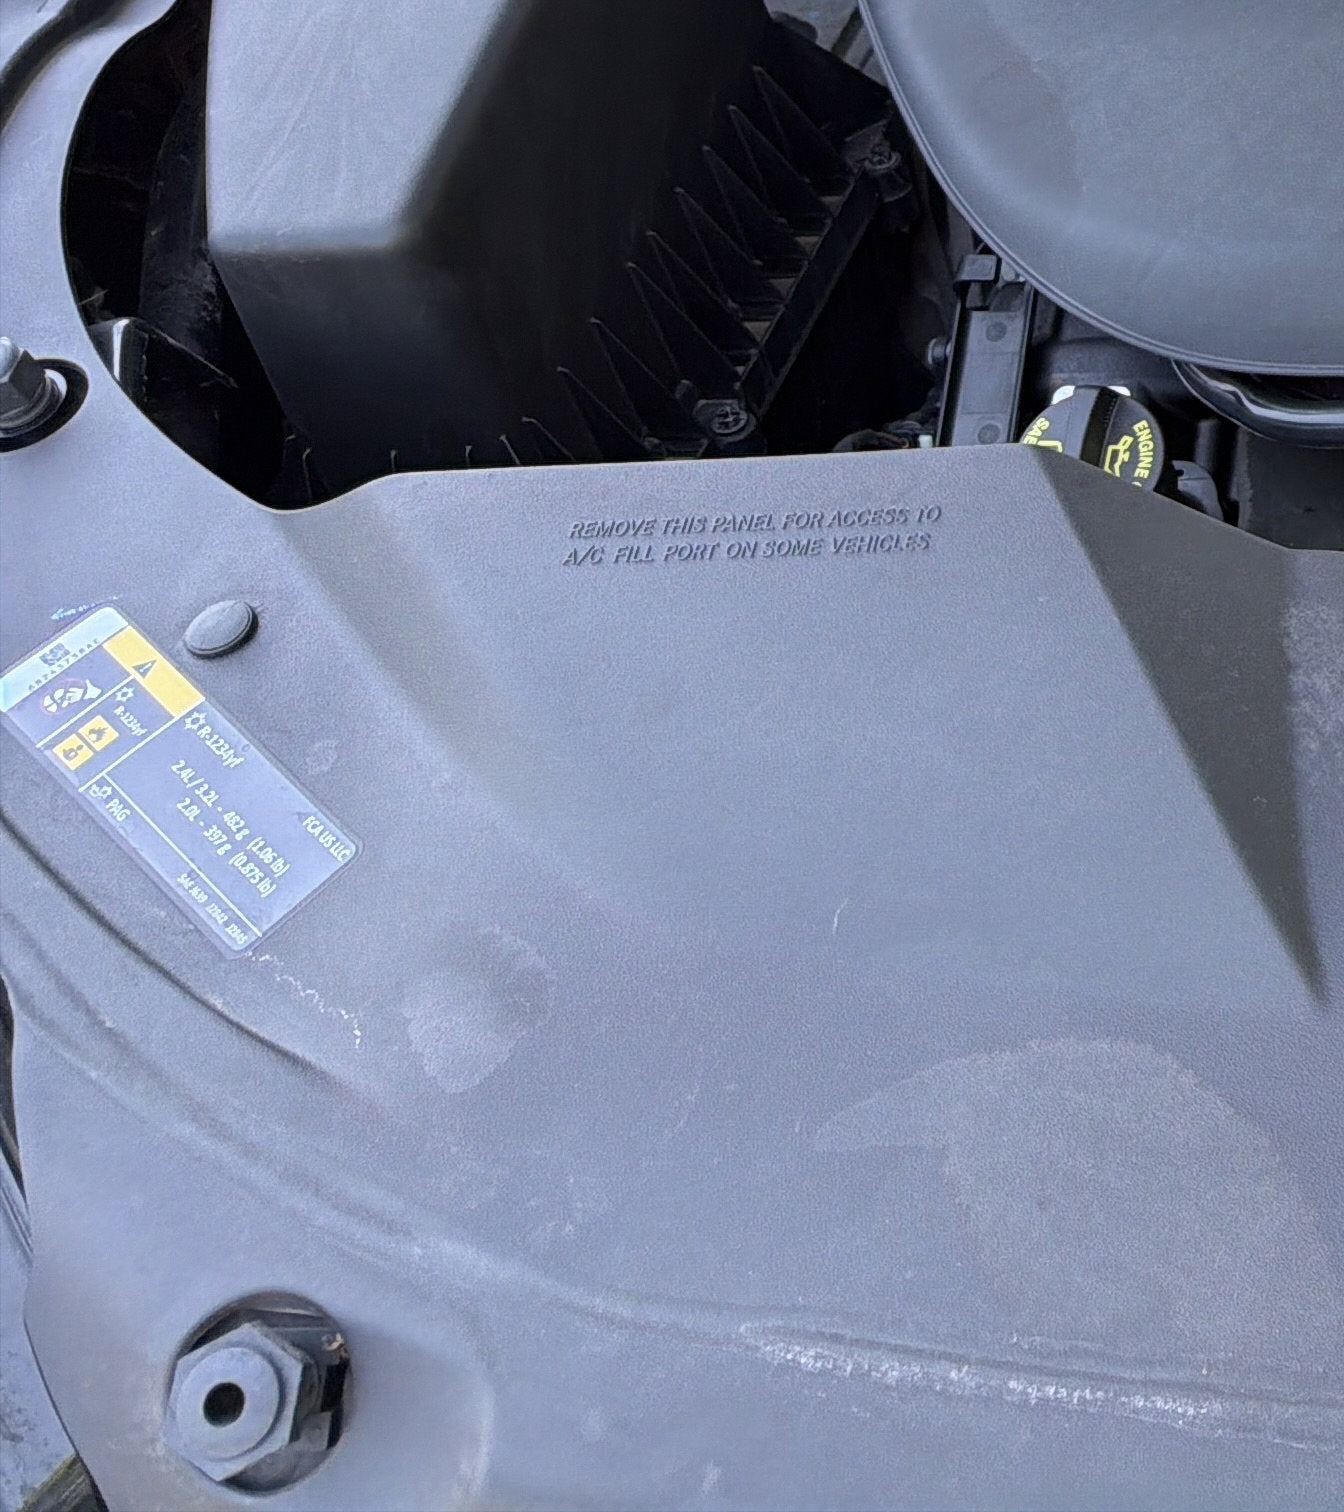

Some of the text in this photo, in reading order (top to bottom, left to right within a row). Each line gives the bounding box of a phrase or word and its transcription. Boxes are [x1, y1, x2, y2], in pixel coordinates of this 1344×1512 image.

[1023, 417, 1051, 445] SAE
[1132, 419, 1155, 479] ENGINE
[569, 504, 942, 539] REMOVE THIS PANEL FOR ACCESS TO
[562, 532, 932, 567] A/C FILL PORT ON SOME VEHICLES
[197, 725, 245, 768] R-1234yf
[105, 798, 131, 822] PAG
[176, 797, 201, 821] 2.0L
[302, 815, 351, 862] FCA US LLC
